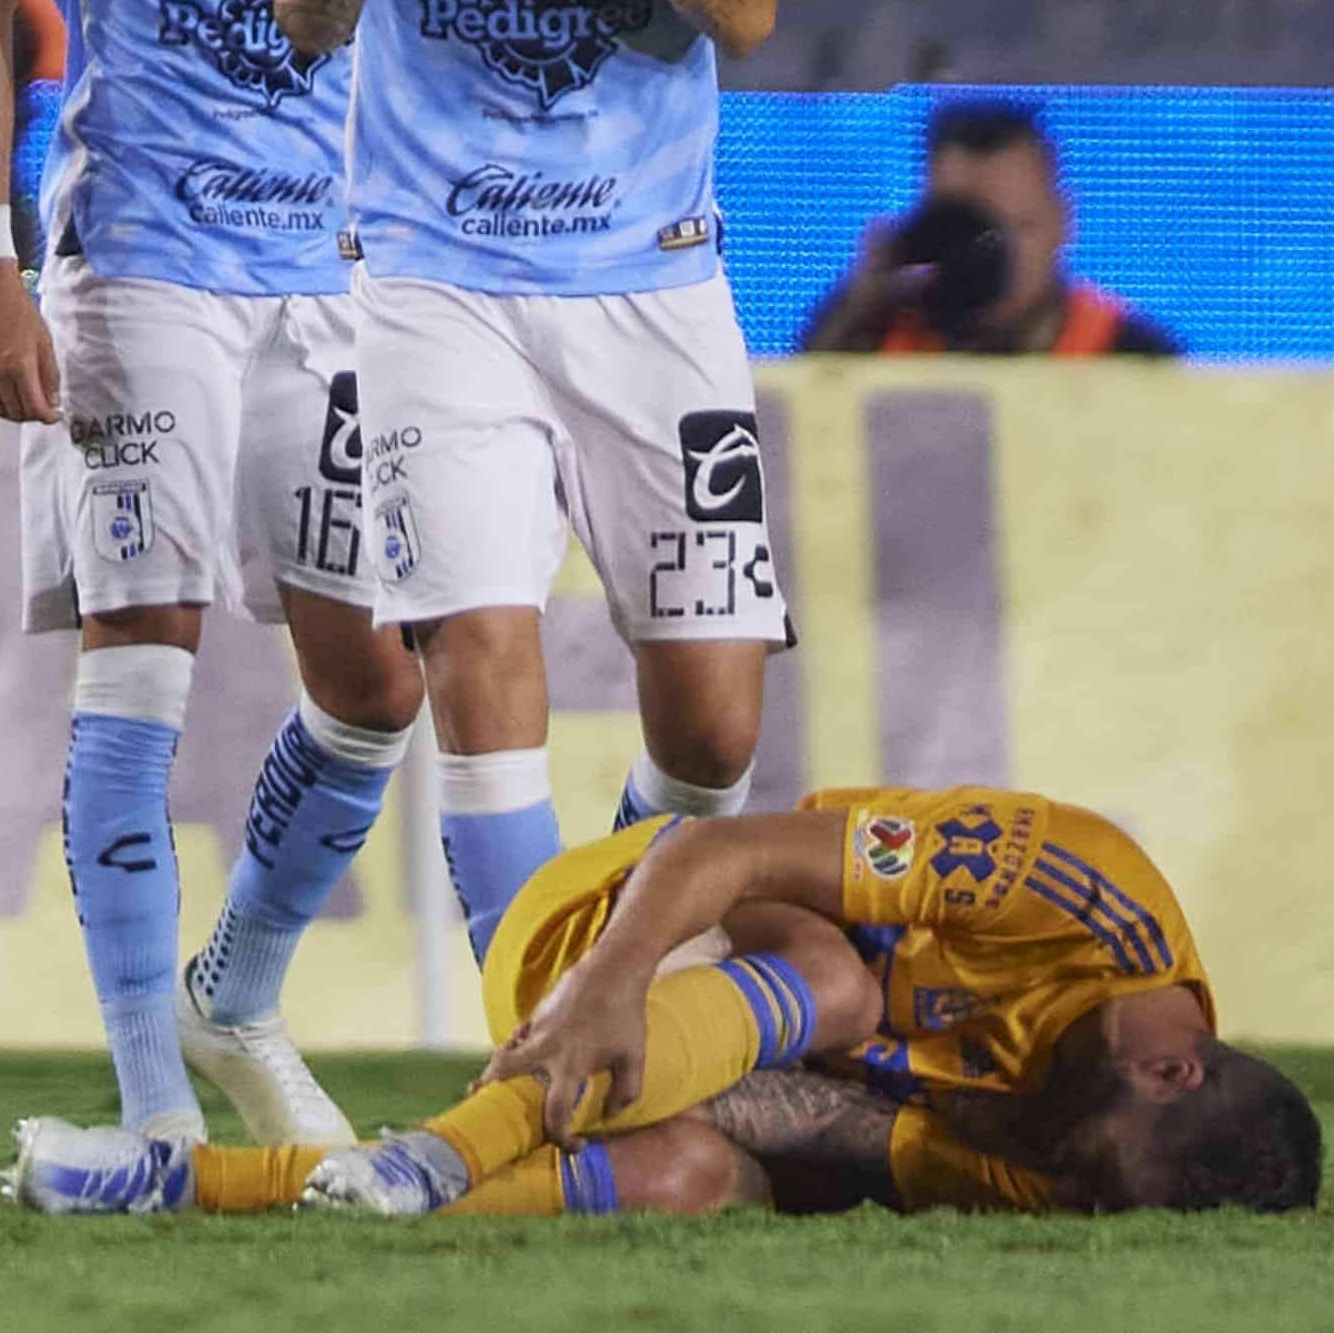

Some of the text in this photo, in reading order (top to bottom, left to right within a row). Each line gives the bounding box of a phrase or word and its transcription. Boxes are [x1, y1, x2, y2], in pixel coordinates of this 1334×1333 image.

[188, 204, 325, 230] caliente.mx
[461, 213, 611, 237] caliente.mx
[84, 441, 159, 469] CLICK
[294, 486, 363, 576] 16
[650, 530, 735, 617] 23
